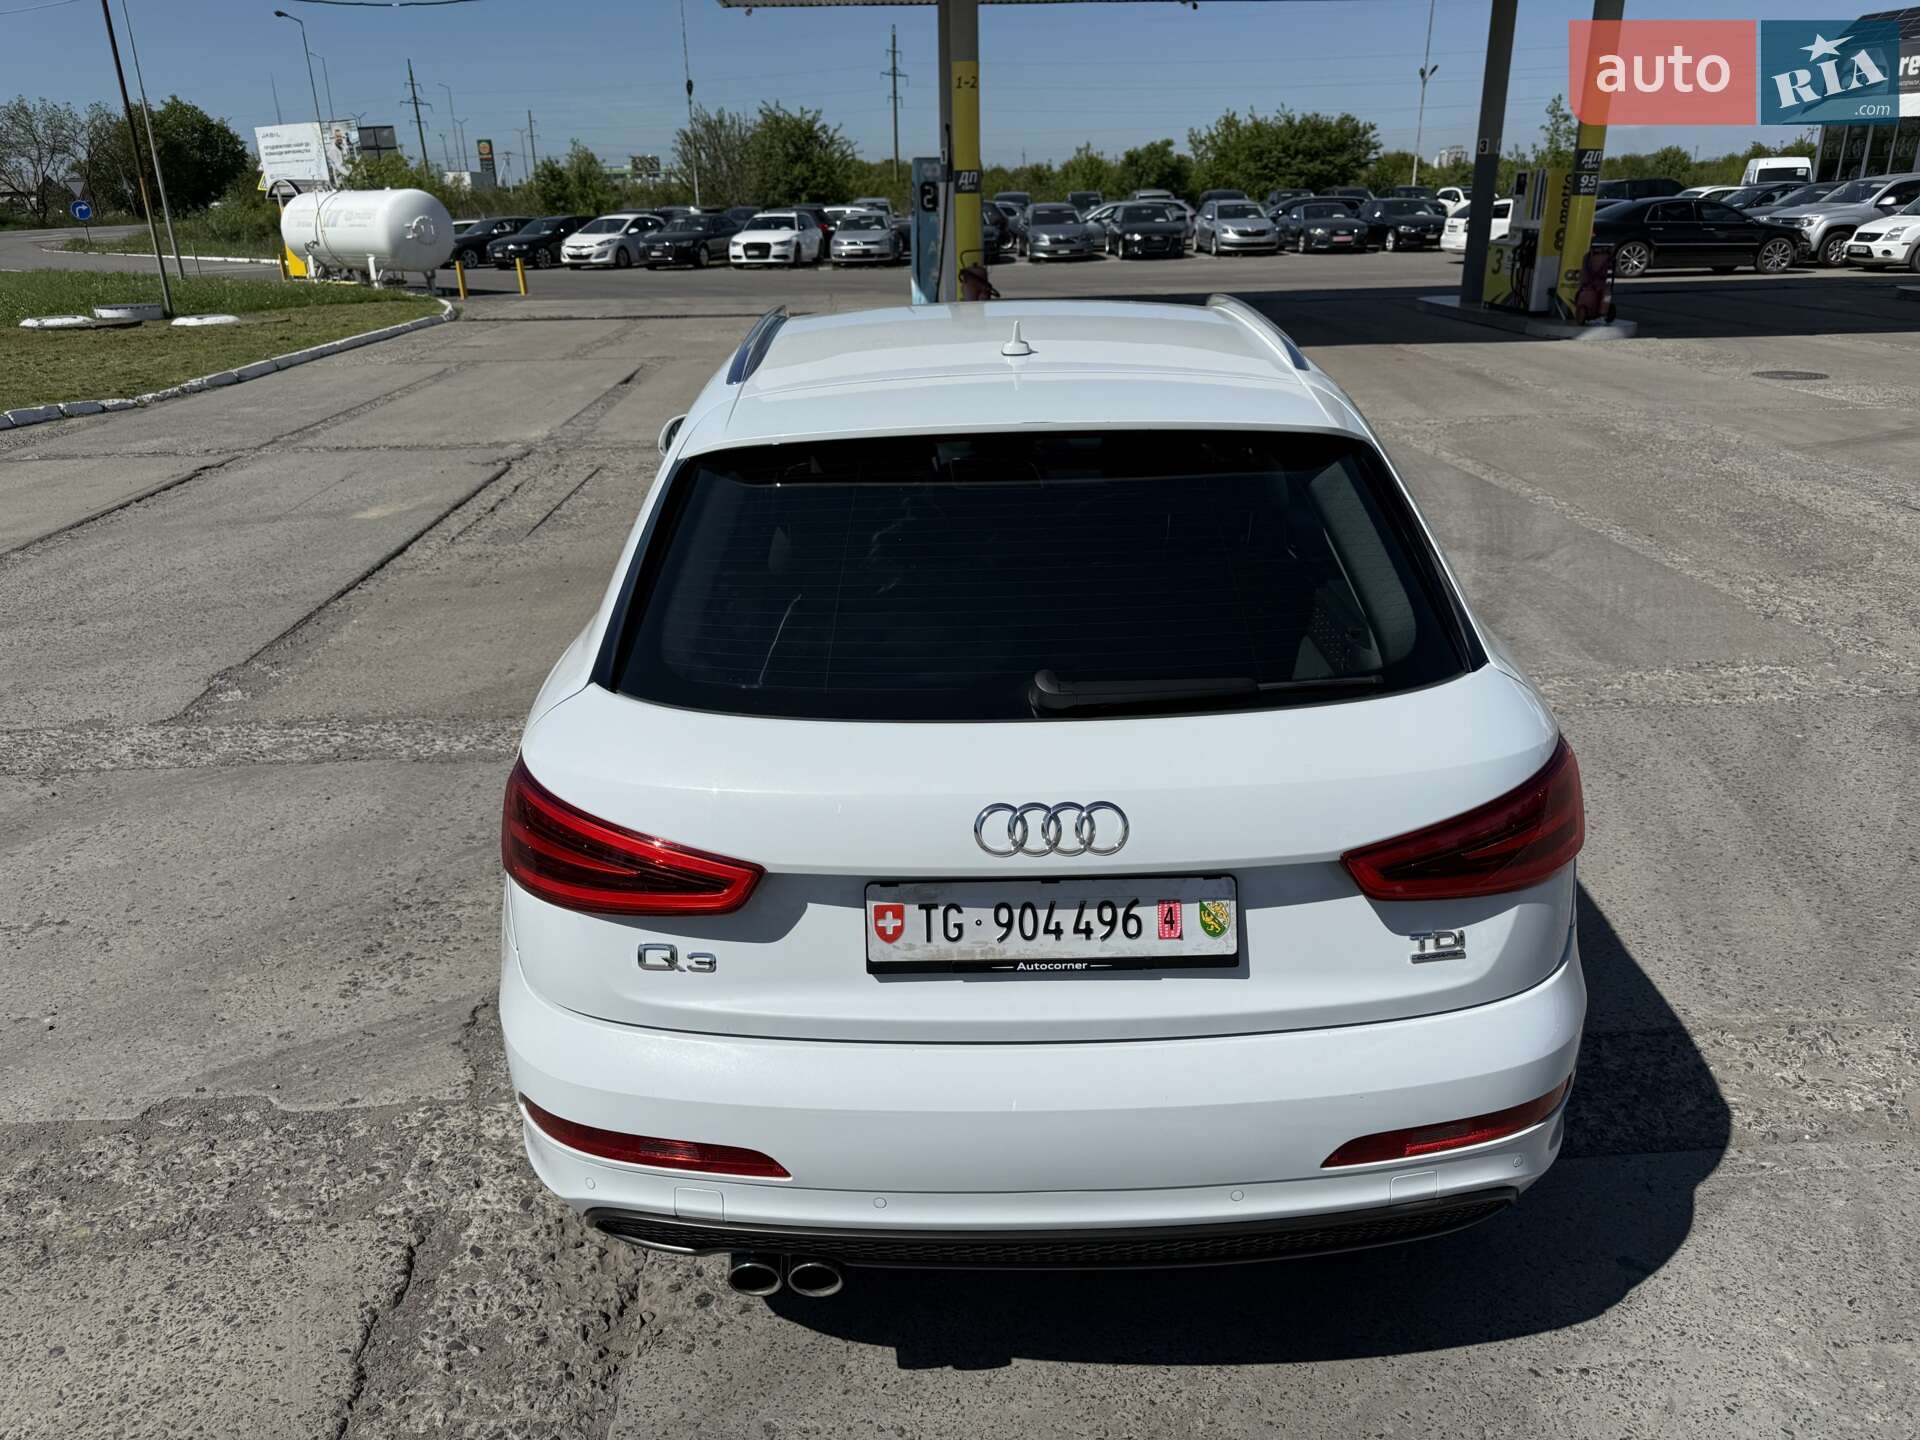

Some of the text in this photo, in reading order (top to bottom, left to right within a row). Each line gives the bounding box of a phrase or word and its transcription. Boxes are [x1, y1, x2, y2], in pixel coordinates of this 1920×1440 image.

[956, 76, 977, 89] 1-2
[1480, 139, 1488, 153] 3
[959, 172, 978, 186] ДП
[1580, 175, 1597, 187] 95
[1491, 248, 1504, 275] 3
[918, 903, 964, 943] TG
[1163, 906, 1175, 931] 4
[1409, 929, 1466, 953] TDI
[637, 943, 717, 973] Q3
[1016, 961, 1088, 971] Autocorner
